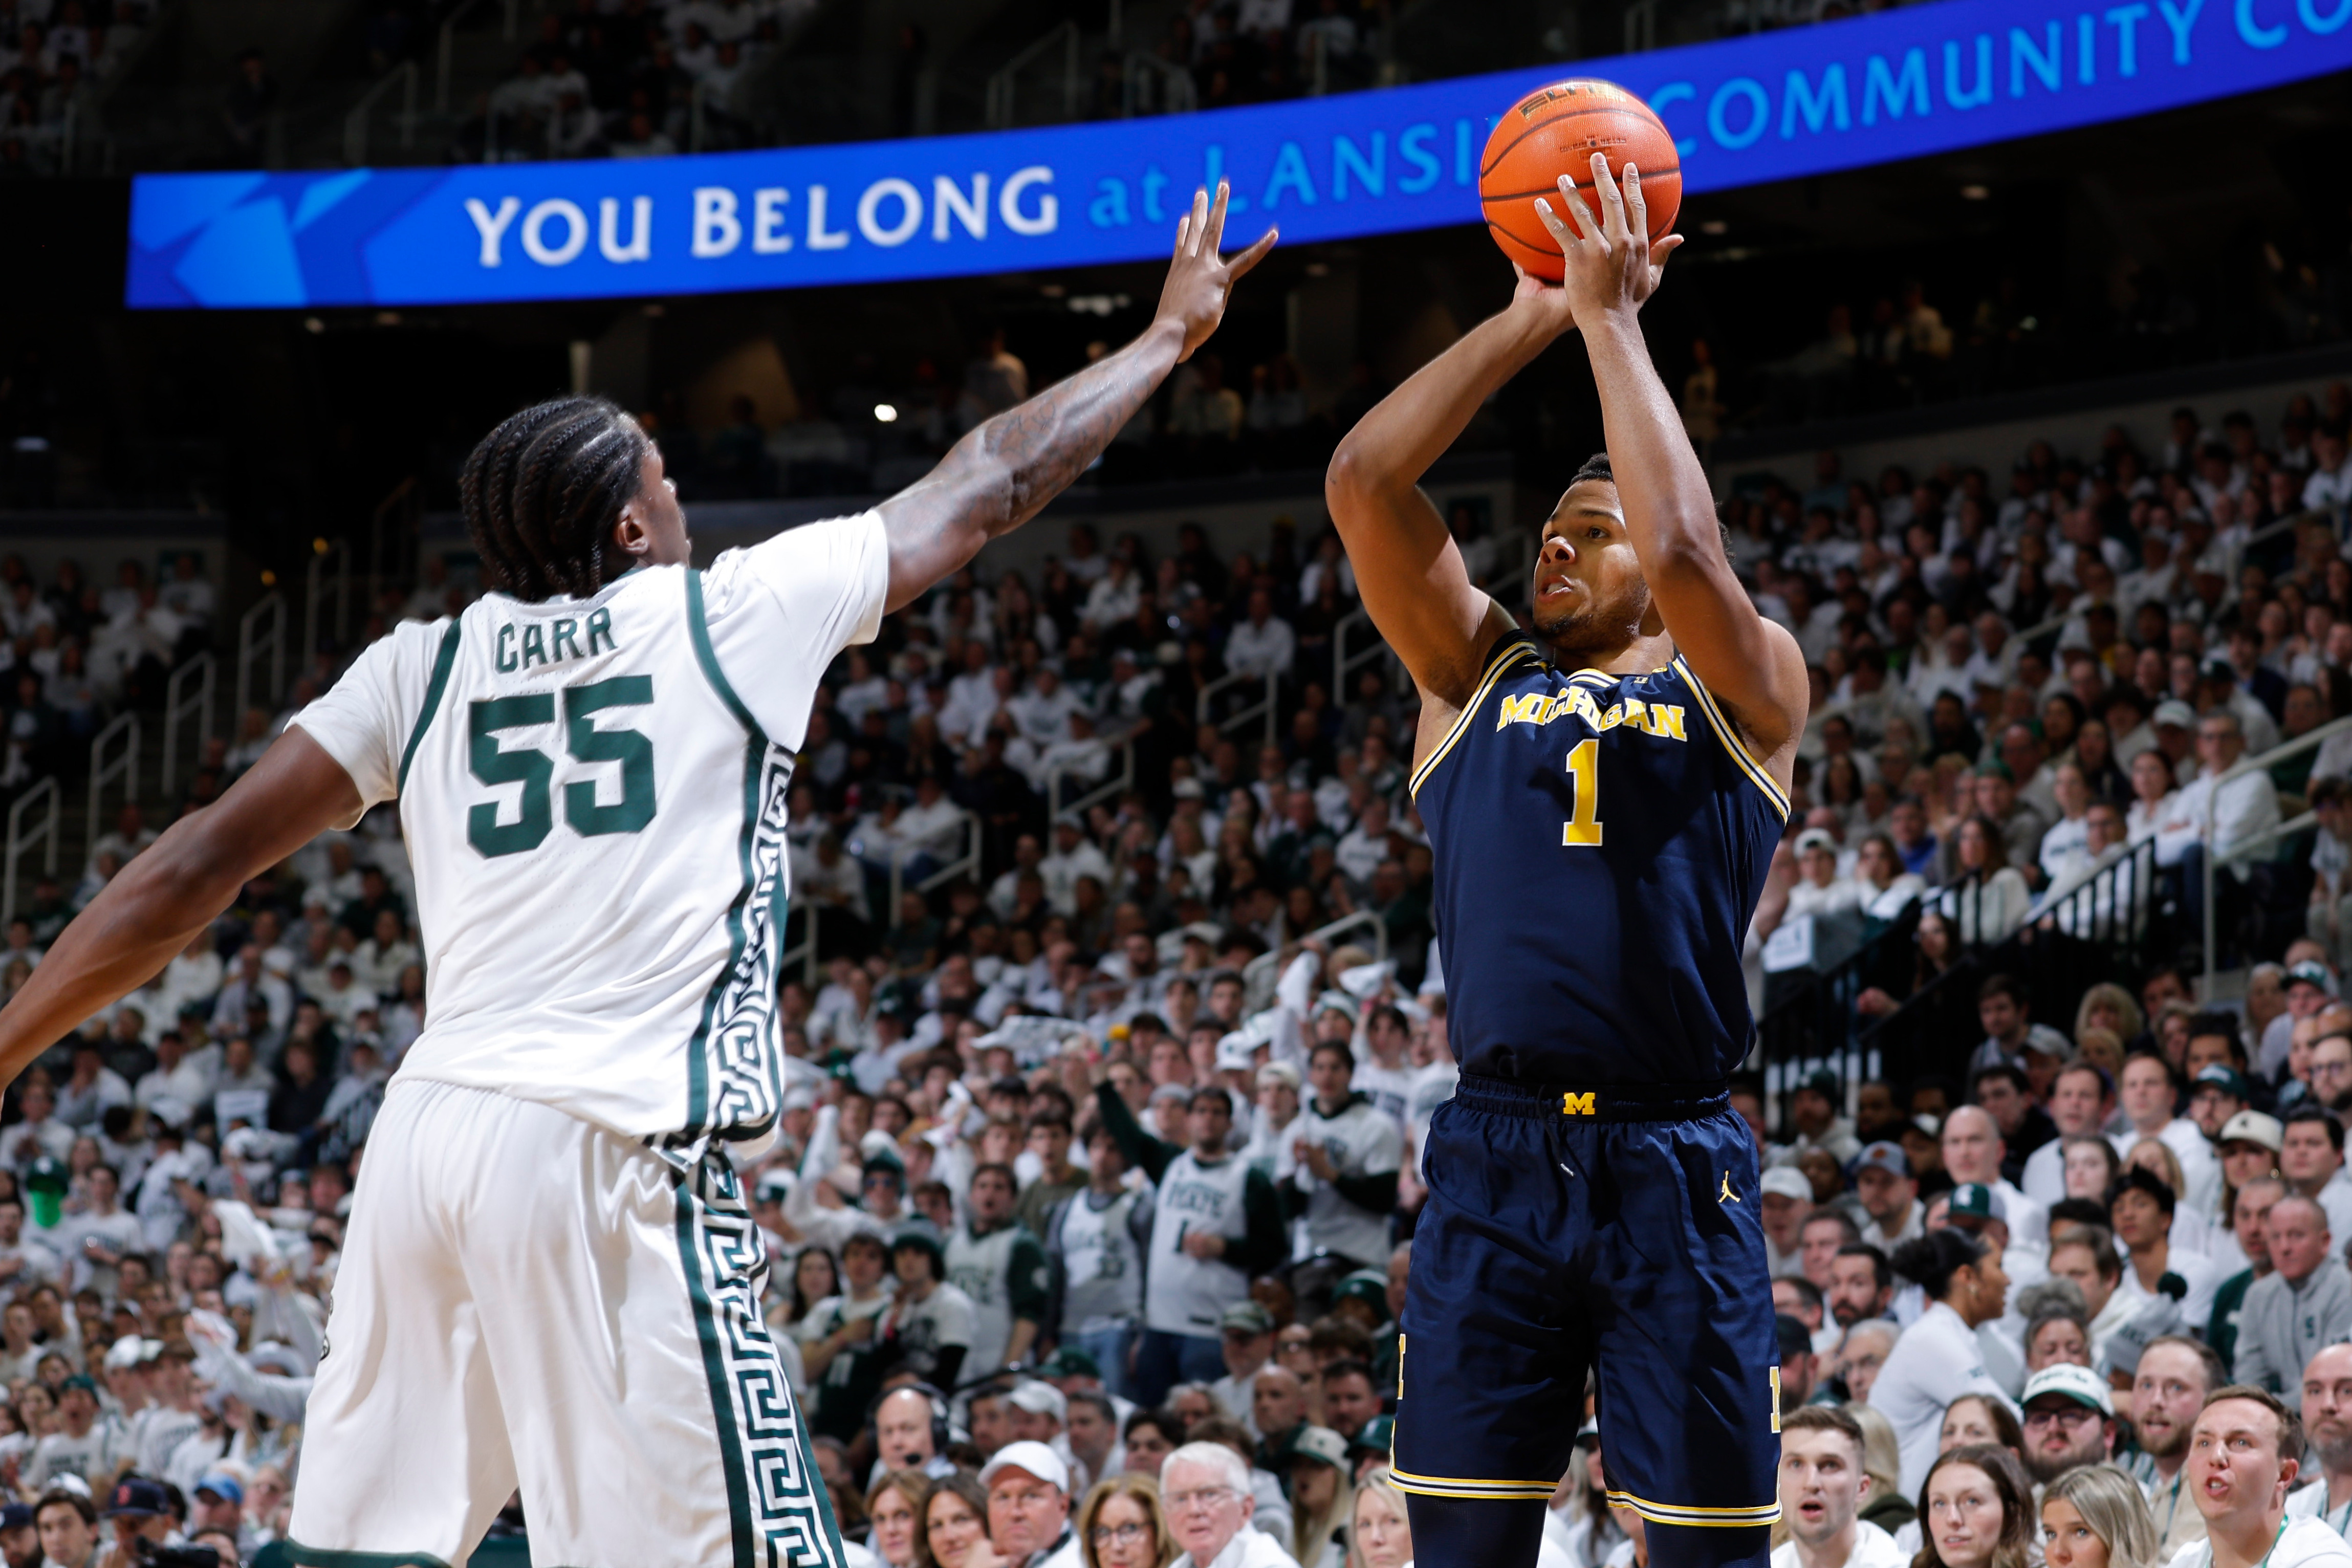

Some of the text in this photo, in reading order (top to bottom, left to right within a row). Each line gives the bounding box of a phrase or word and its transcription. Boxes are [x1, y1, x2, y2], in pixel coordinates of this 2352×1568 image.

[465, 195, 652, 268] YOU
[691, 166, 1058, 258] BELONG
[1090, 169, 1167, 226] at
[1204, 115, 1499, 213] LANSI
[1647, 0, 2204, 157] COMMUNITY
[494, 606, 618, 674] CARR
[467, 674, 656, 860] 55
[1562, 738, 1603, 846] 1
[1563, 1092, 1596, 1115] M
